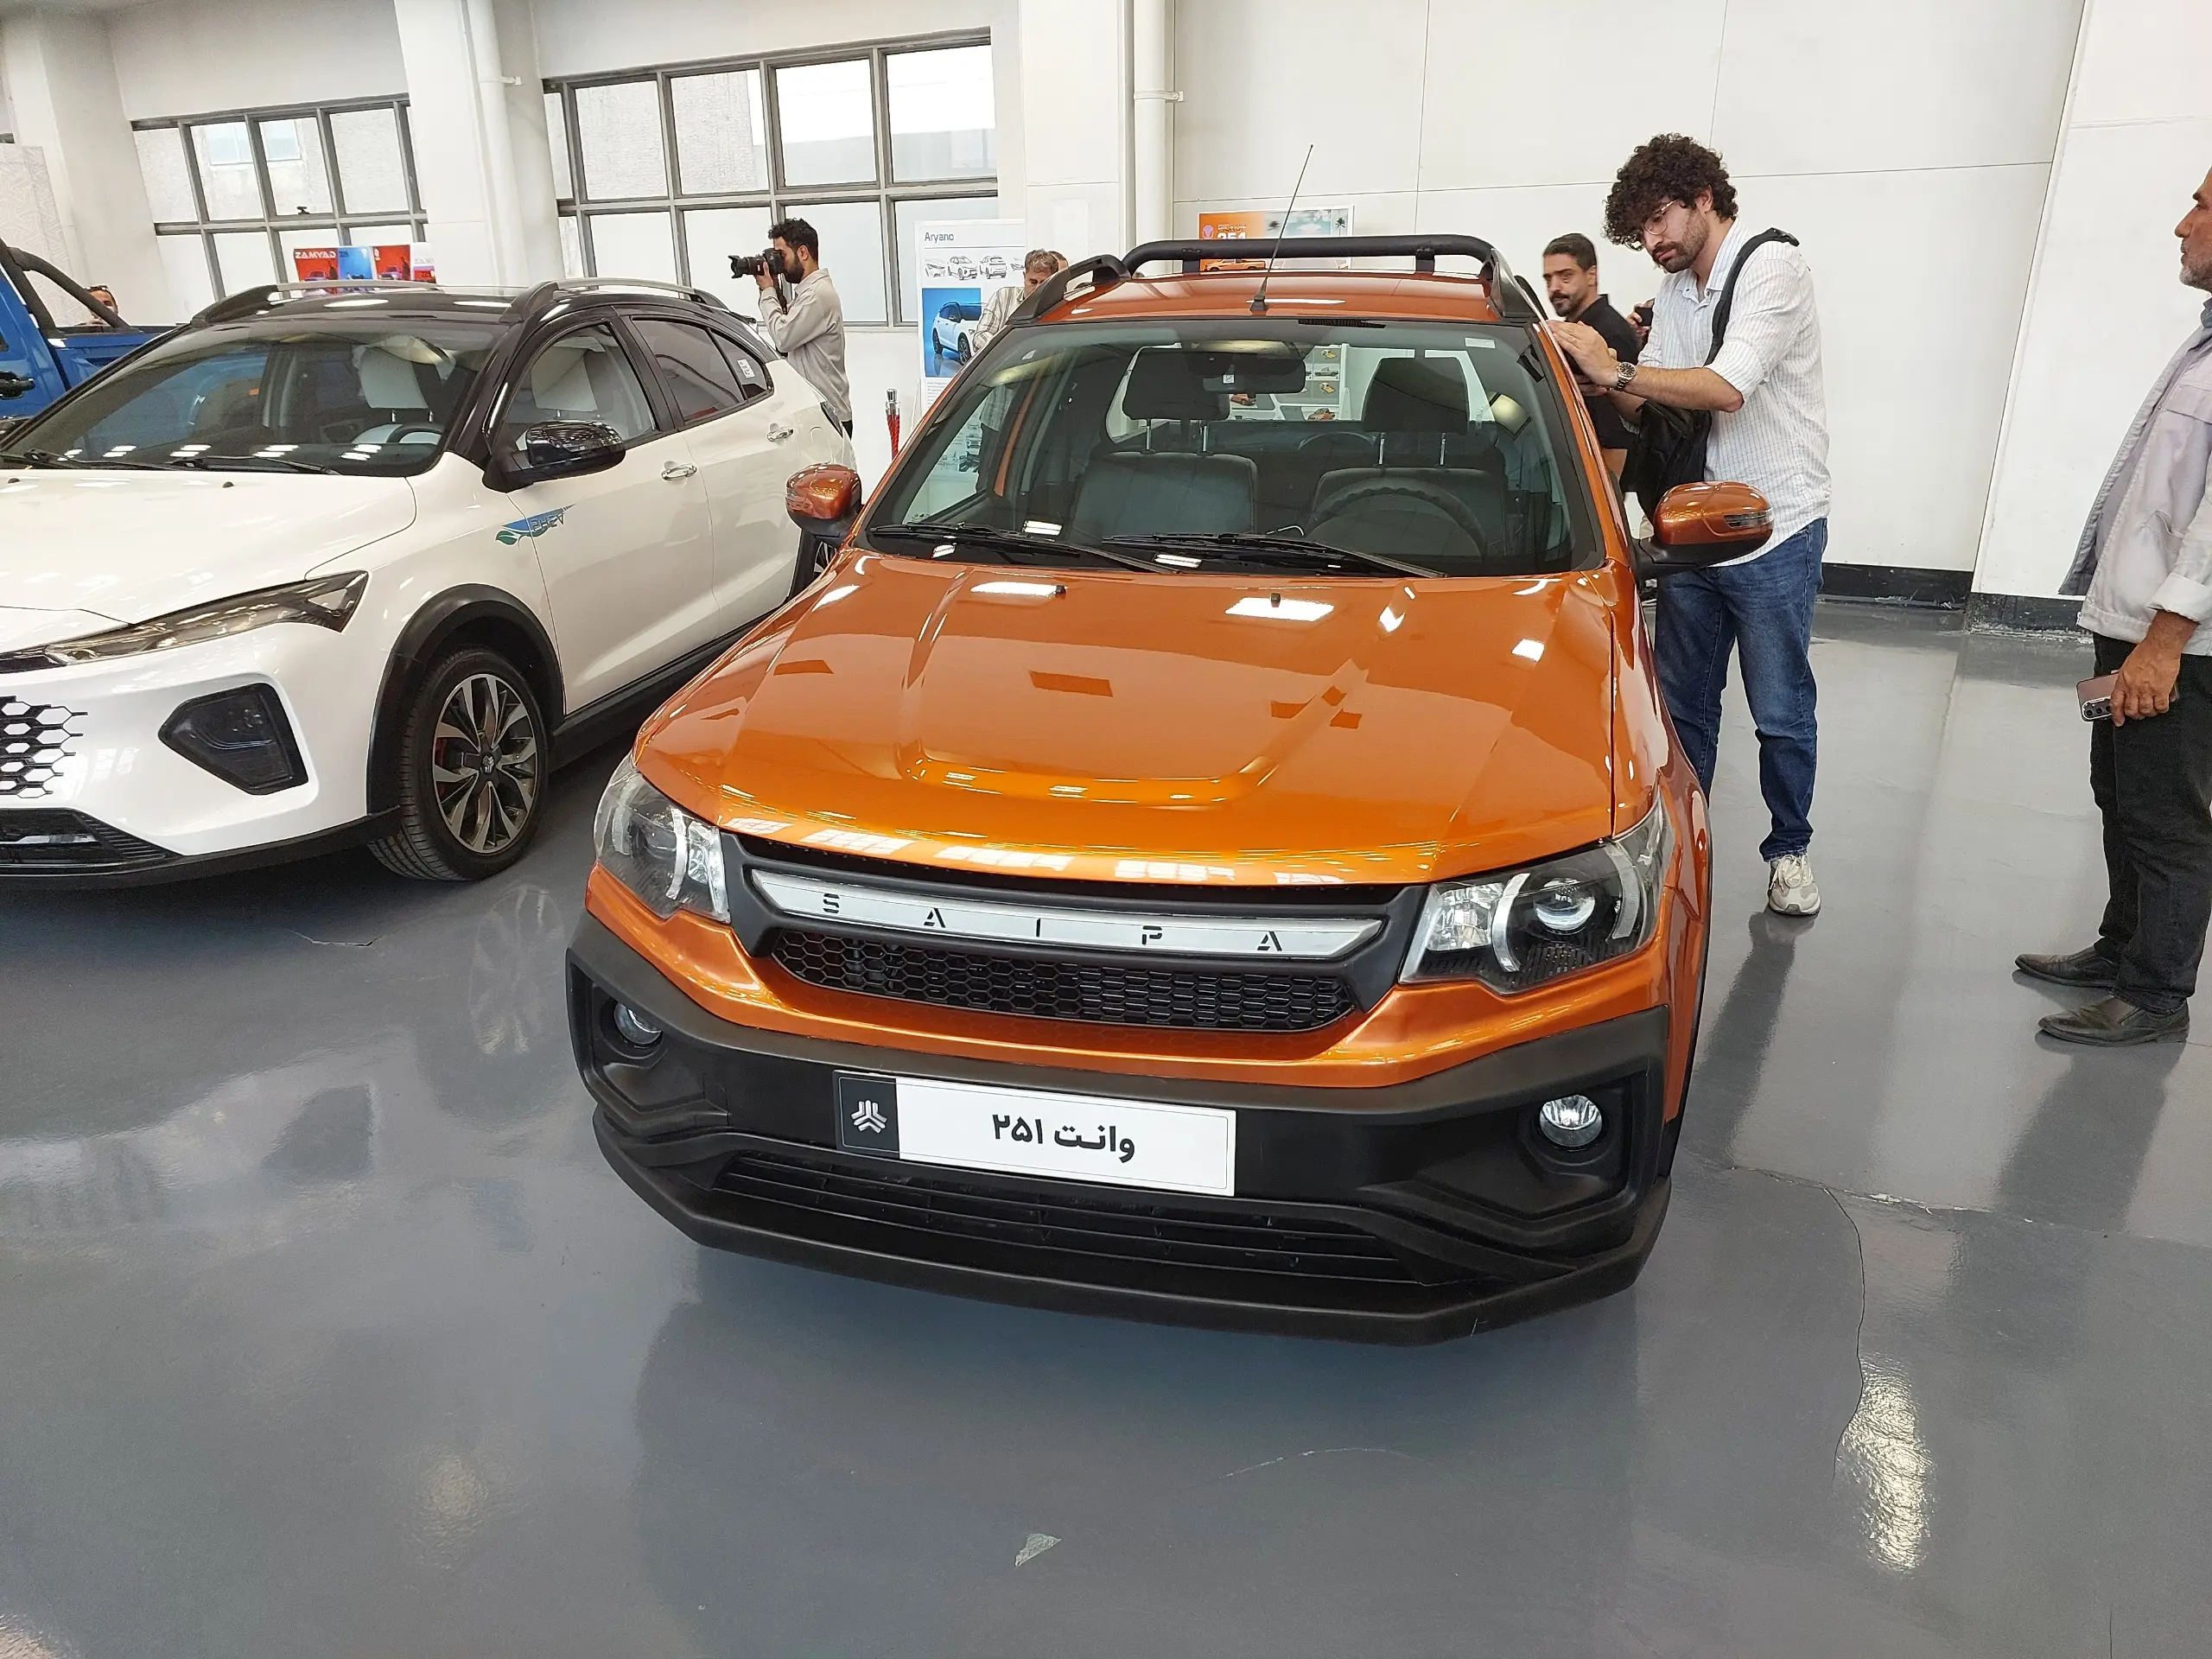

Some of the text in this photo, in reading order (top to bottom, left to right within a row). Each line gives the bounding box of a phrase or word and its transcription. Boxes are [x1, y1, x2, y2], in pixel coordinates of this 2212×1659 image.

[924, 232, 955, 244] Aryano
[295, 251, 336, 259] ZAMYAD
[530, 512, 564, 532] PHEV
[823, 893, 1282, 952] SAIPA
[991, 1114, 1135, 1162] وانت ۲۵۱
